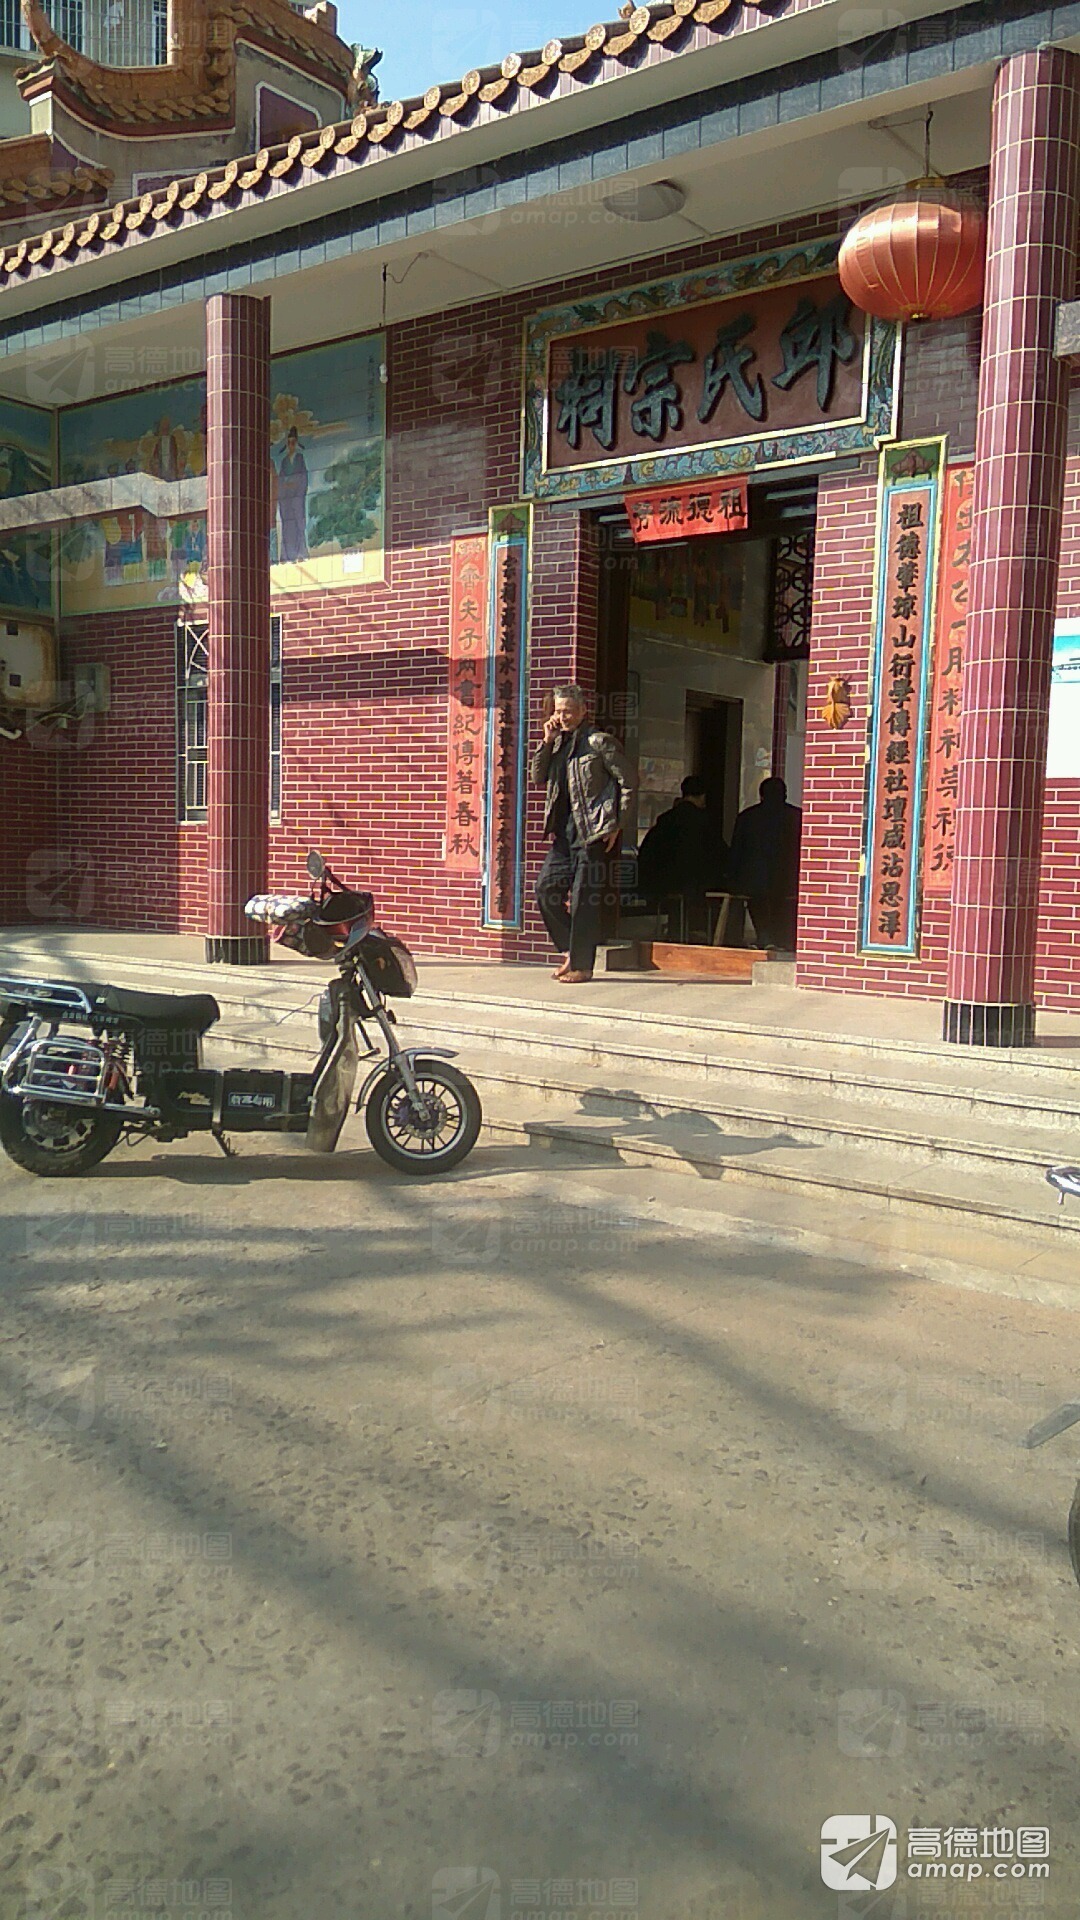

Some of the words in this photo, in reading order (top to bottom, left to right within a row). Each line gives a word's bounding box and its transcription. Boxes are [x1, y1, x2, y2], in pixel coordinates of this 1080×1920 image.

[555, 301, 856, 449] 邱氏宗祠
[631, 487, 748, 532] 祖德流芳
